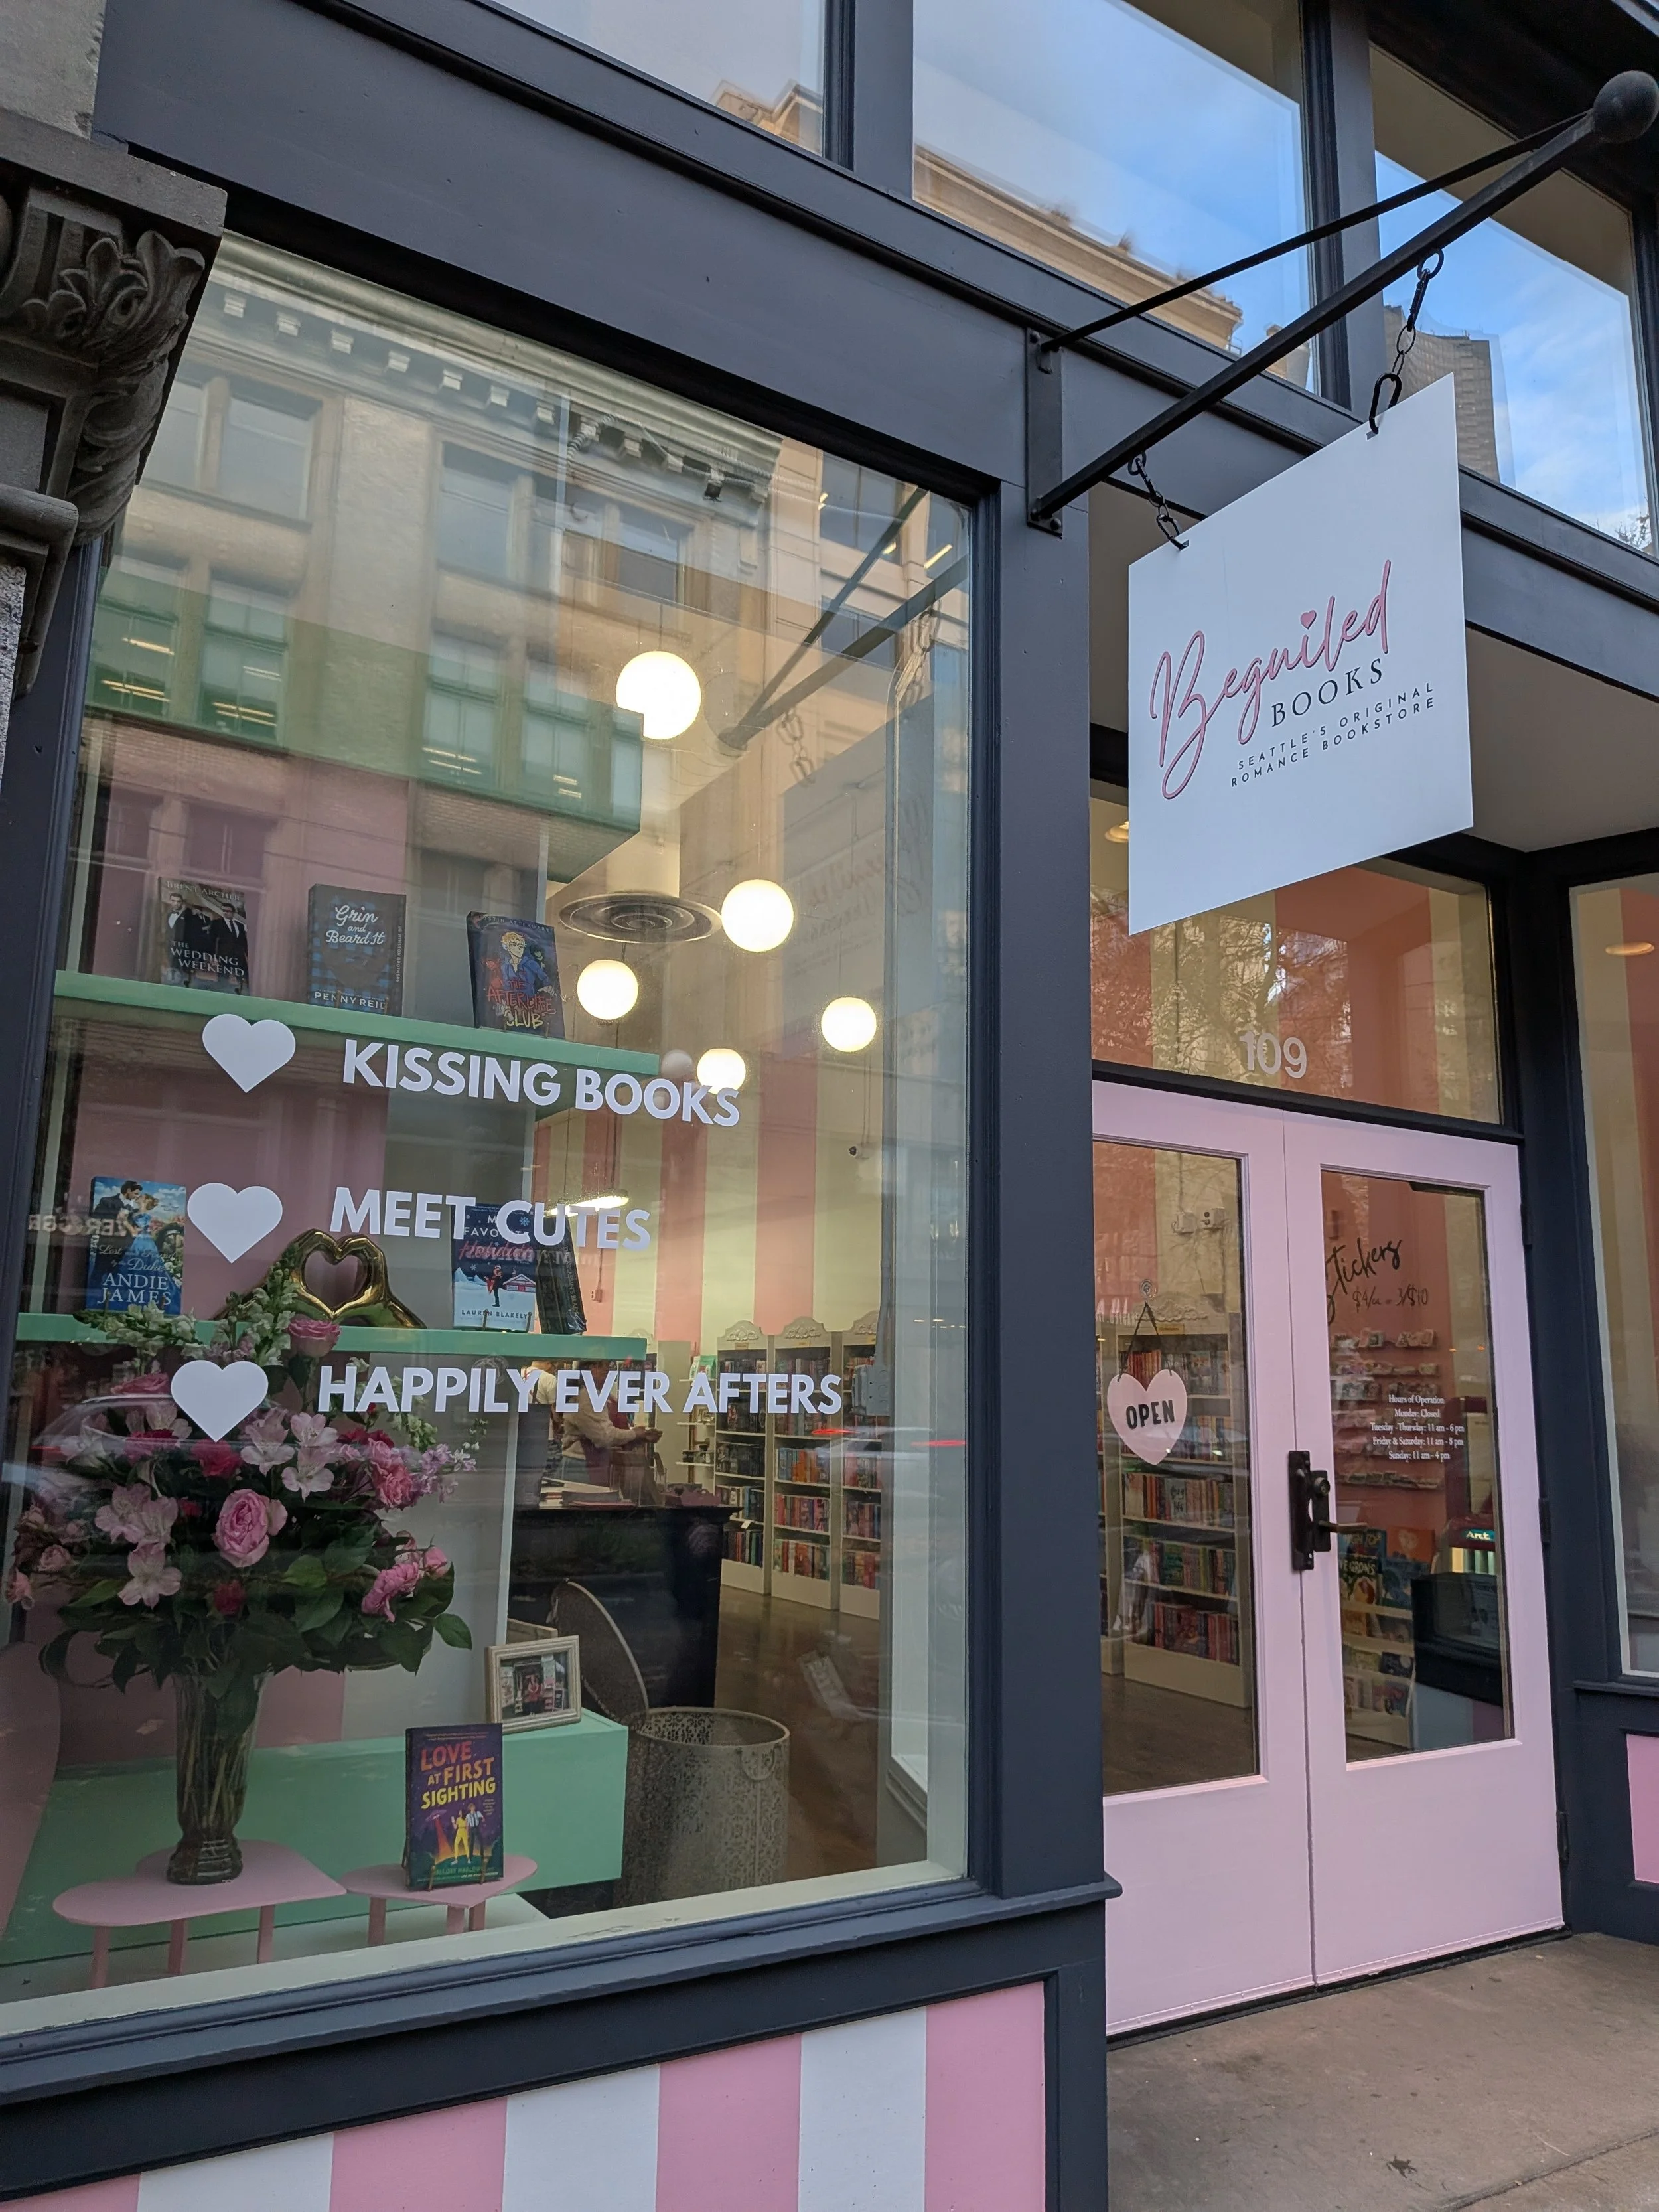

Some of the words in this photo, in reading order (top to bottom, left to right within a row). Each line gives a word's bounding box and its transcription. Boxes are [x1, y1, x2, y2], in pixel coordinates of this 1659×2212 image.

[1149, 559, 1391, 799] Beguiled
[1271, 658, 1383, 728] BOOKS
[1238, 726, 1326, 770] SEATTLE'S
[1339, 682, 1433, 728] ORIGINAL
[1231, 747, 1309, 787] ROMANCE
[1322, 697, 1433, 751] BOOKSTORE
[335, 905, 378, 926] Grin
[348, 923, 368, 932] and
[325, 930, 370, 944] Beard
[370, 930, 385, 945] It
[170, 947, 238, 966] WEDDING
[178, 958, 244, 976] WEEKEND
[509, 978, 526, 990] THE
[314, 992, 356, 1004] PENNY
[504, 1009, 543, 1029] CLUB
[1239, 1030, 1308, 1079] 109
[342, 1039, 561, 1106] KISSING
[575, 1067, 741, 1128] BOOKS
[329, 1187, 476, 1240] MEET
[496, 1199, 651, 1252] CUTES
[98, 1244, 123, 1256] Lost
[102, 1272, 169, 1290] ANDIE
[97, 1288, 171, 1306] JAMES
[317, 1365, 543, 1413] HAPPILY
[555, 1369, 674, 1414] EVER
[682, 1372, 842, 1416] AFTERS
[1388, 1394, 1407, 1404] Hours
[1408, 1394, 1415, 1404] of
[1415, 1394, 1445, 1406] Operation
[1125, 1399, 1175, 1430] OPEN
[1394, 1408, 1420, 1420] Monday:
[1420, 1408, 1441, 1418] Closed
[1369, 1422, 1393, 1434] Tuesday
[1397, 1422, 1426, 1435] Thursday:
[1427, 1423, 1435, 1432] 11
[1449, 1423, 1454, 1432] 6
[1455, 1426, 1465, 1435] pm
[1372, 1436, 1391, 1449] Friday
[1392, 1437, 1398, 1445] &
[1398, 1436, 1425, 1449] Saturday:
[1427, 1437, 1434, 1445] 11
[1449, 1437, 1453, 1446] 8
[1454, 1440, 1464, 1449] pm
[1388, 1450, 1411, 1463] Sunday:
[1412, 1451, 1419, 1459] 11
[1435, 1451, 1439, 1459] 4
[1440, 1454, 1451, 1463] pm
[421, 1740, 472, 1771] LOVE
[427, 1773, 441, 1786] AT
[443, 1757, 495, 1787] FIRST
[421, 1777, 496, 1810] SIGHTING
